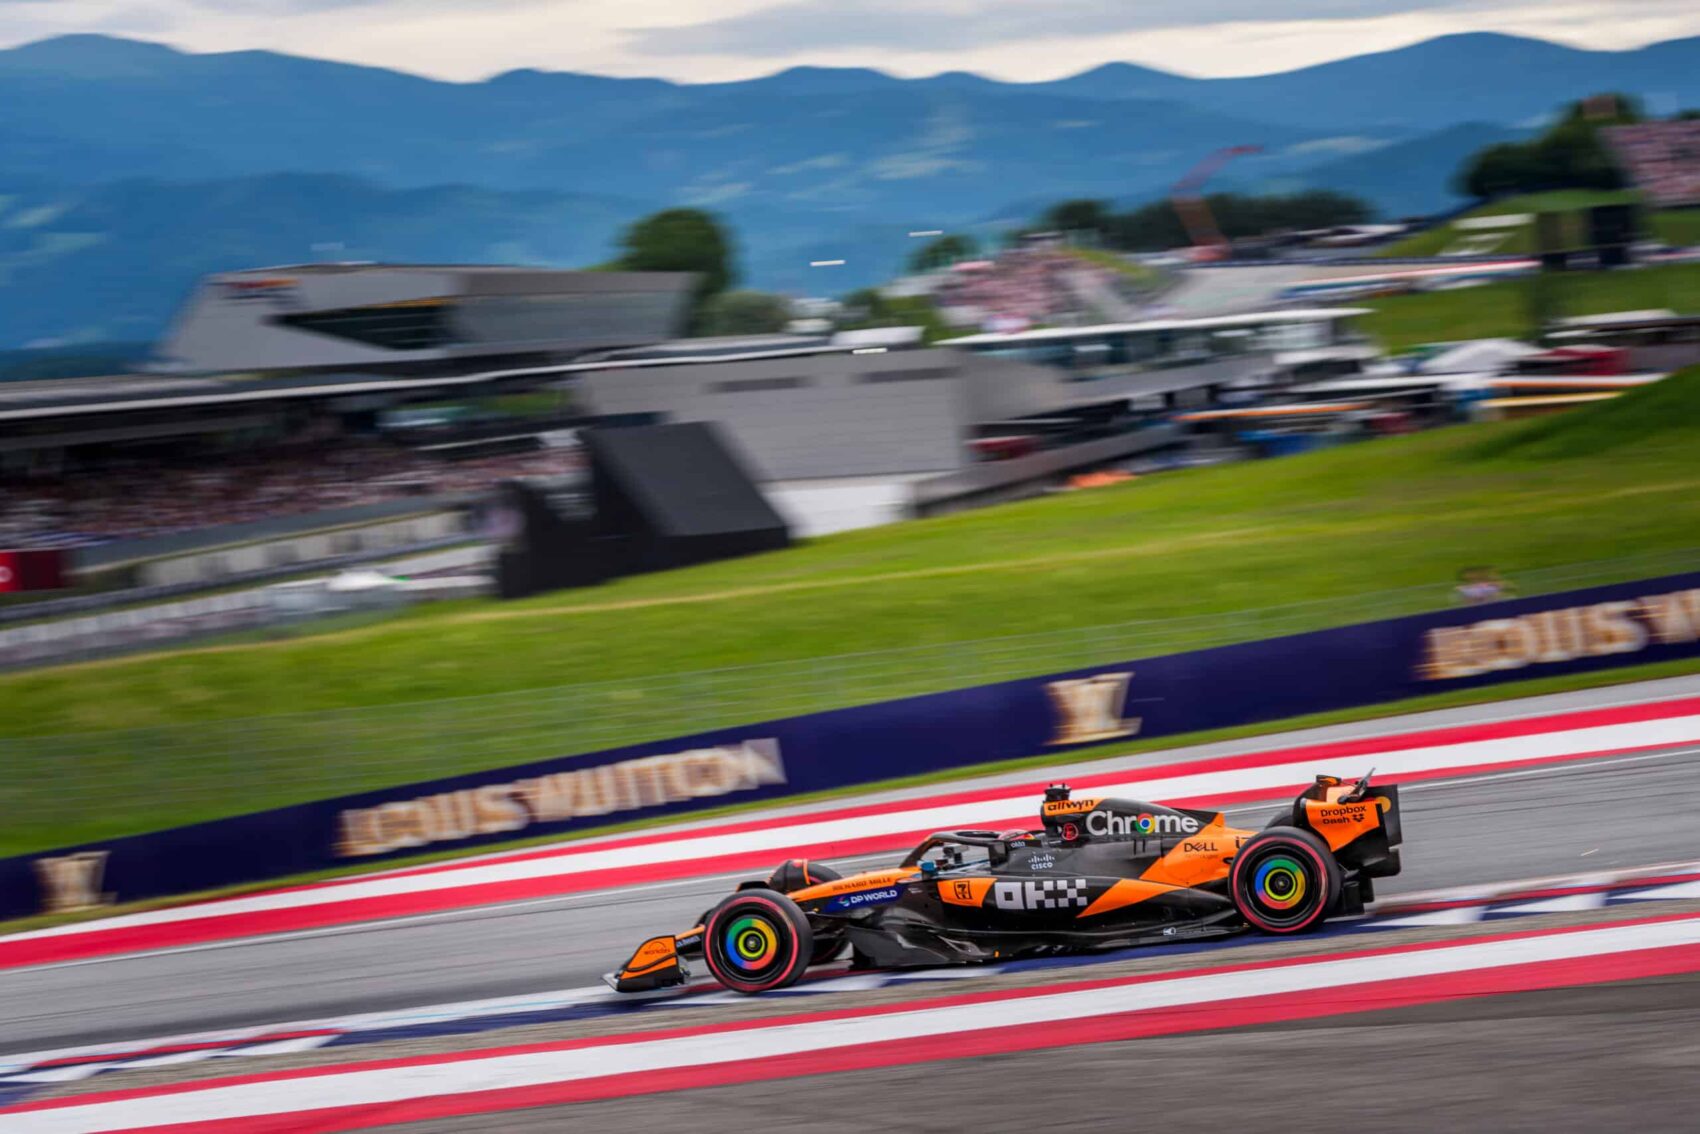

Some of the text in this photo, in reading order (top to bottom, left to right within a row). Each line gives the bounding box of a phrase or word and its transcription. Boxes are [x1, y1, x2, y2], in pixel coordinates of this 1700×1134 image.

[1047, 799, 1095, 811] allwyn
[1320, 805, 1367, 817] Dropbox
[1086, 810, 1199, 836] Chrome
[1323, 815, 1350, 825] Dash
[1184, 842, 1219, 853] DELL
[850, 889, 898, 904] DP WORLD
[994, 878, 1088, 910] OKX
